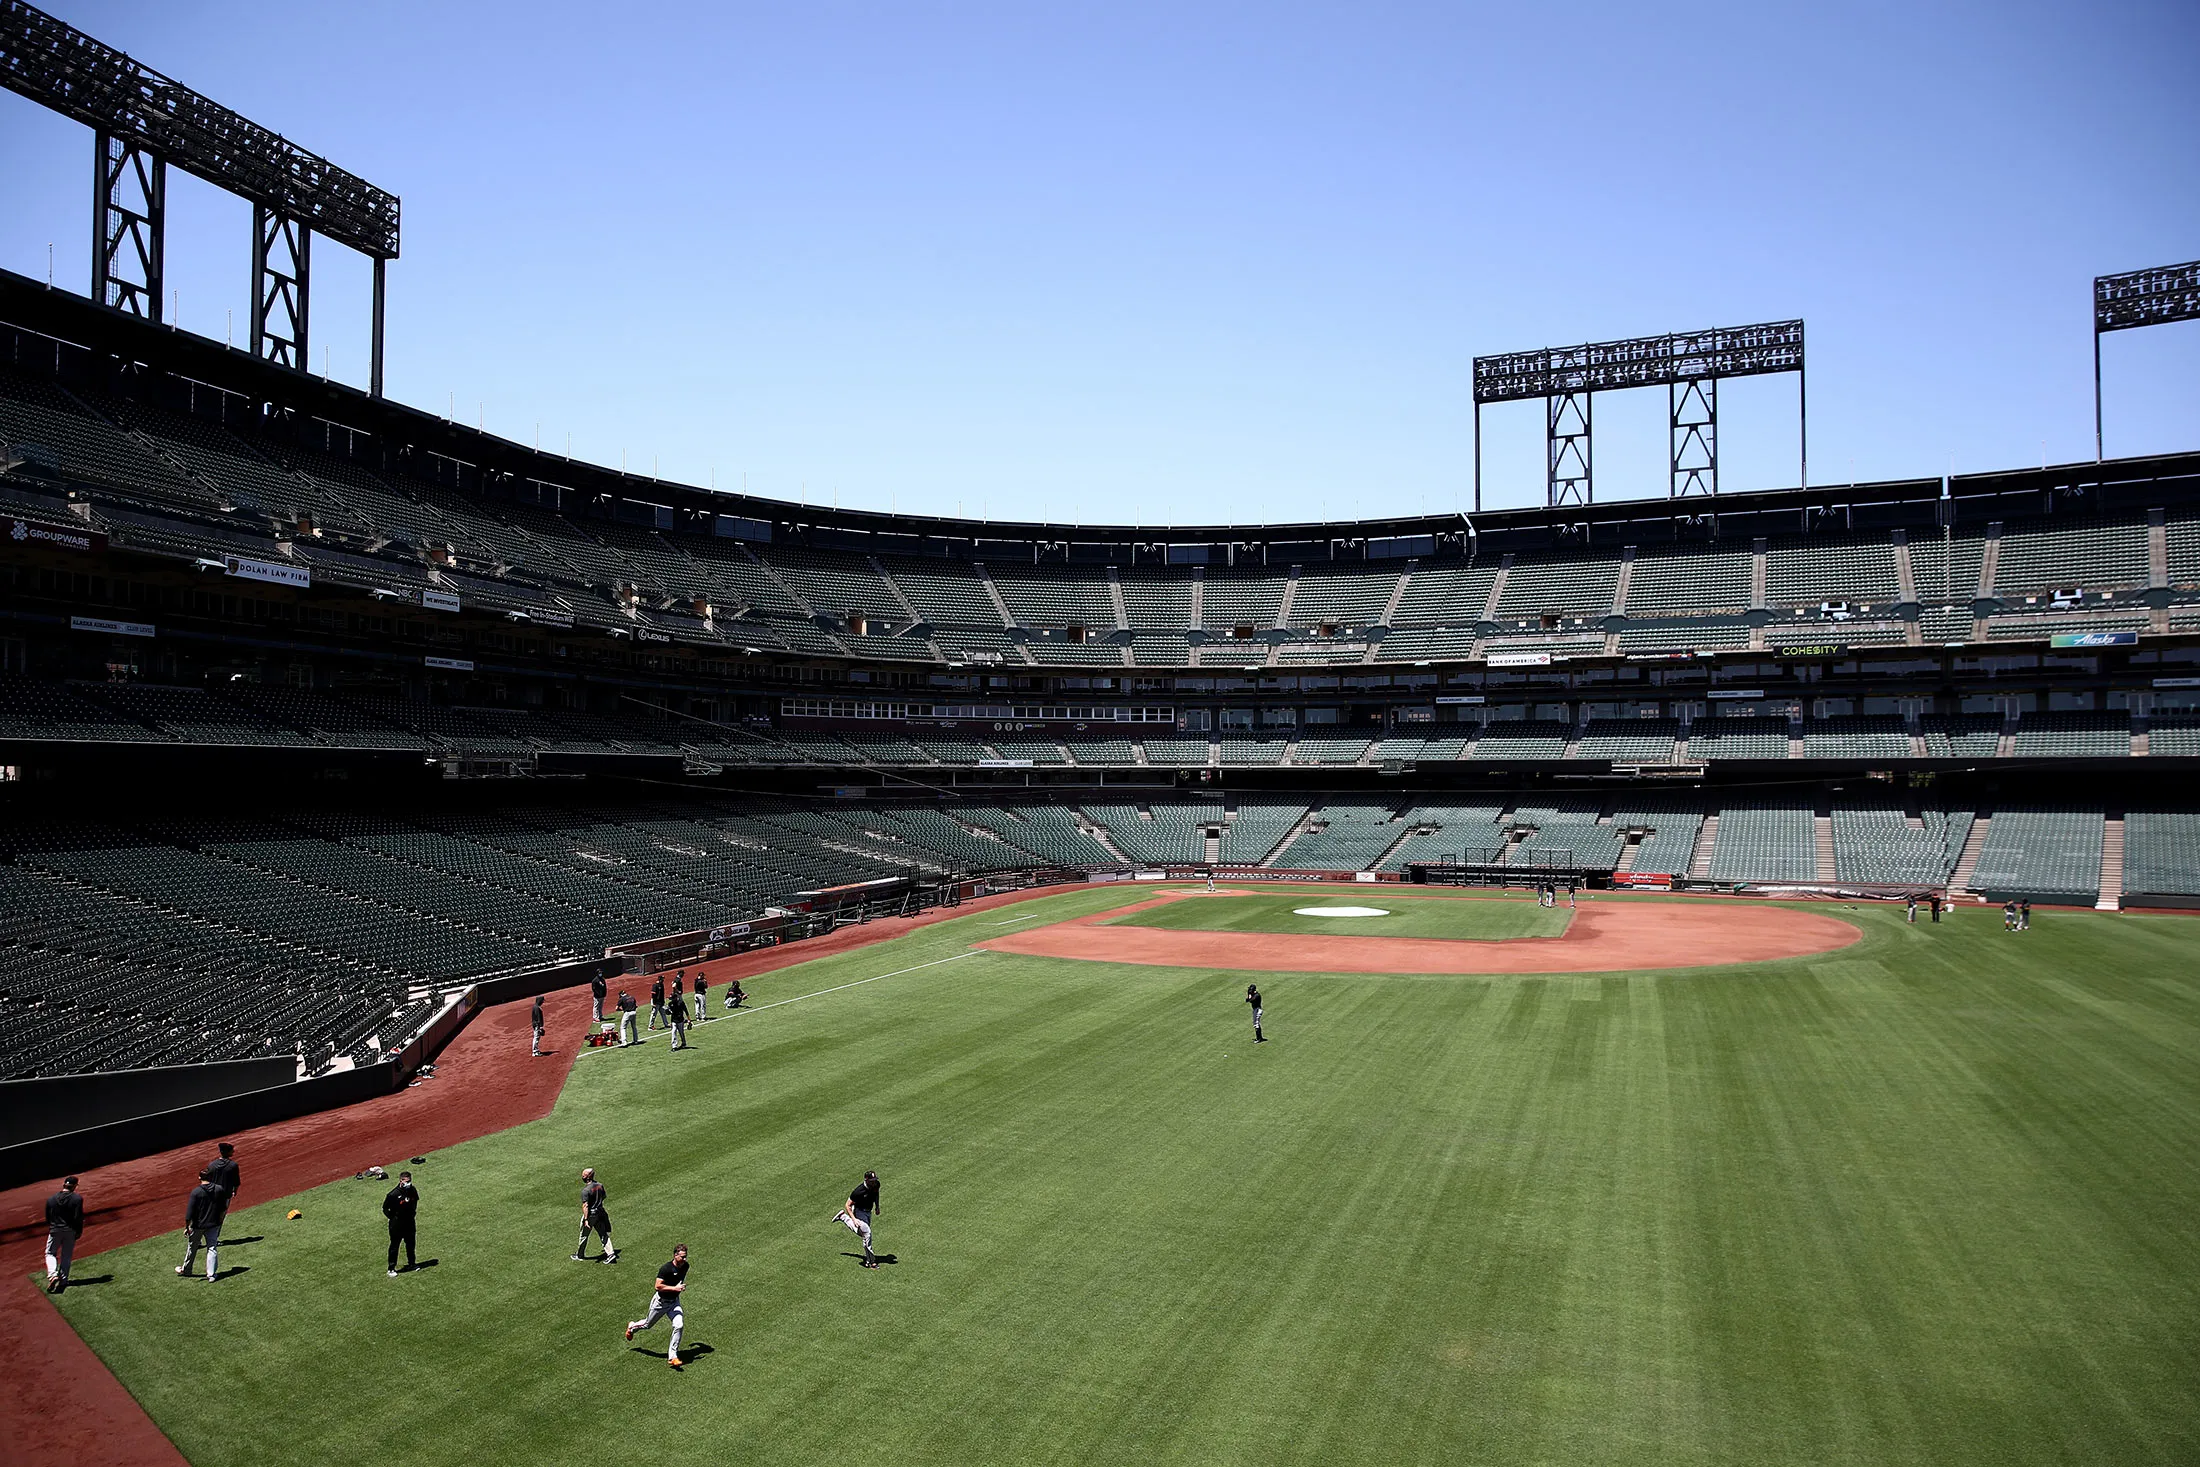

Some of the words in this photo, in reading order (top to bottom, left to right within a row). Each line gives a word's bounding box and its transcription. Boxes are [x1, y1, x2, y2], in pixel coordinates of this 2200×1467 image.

[29, 529, 91, 547] GROUPWARE
[57, 541, 90, 551] TECHNOLOGY
[240, 564, 268, 575] DOLAN
[271, 569, 288, 578] LAW
[290, 573, 309, 582] FIRM
[398, 588, 413, 599] NBC
[433, 597, 458, 607] INVESTIGATE
[529, 609, 540, 617] Free
[647, 632, 670, 643] LEXUS
[2073, 633, 2116, 646] Alaska
[1782, 645, 1839, 656] COHESITY
[1629, 873, 1654, 883] xfinity
